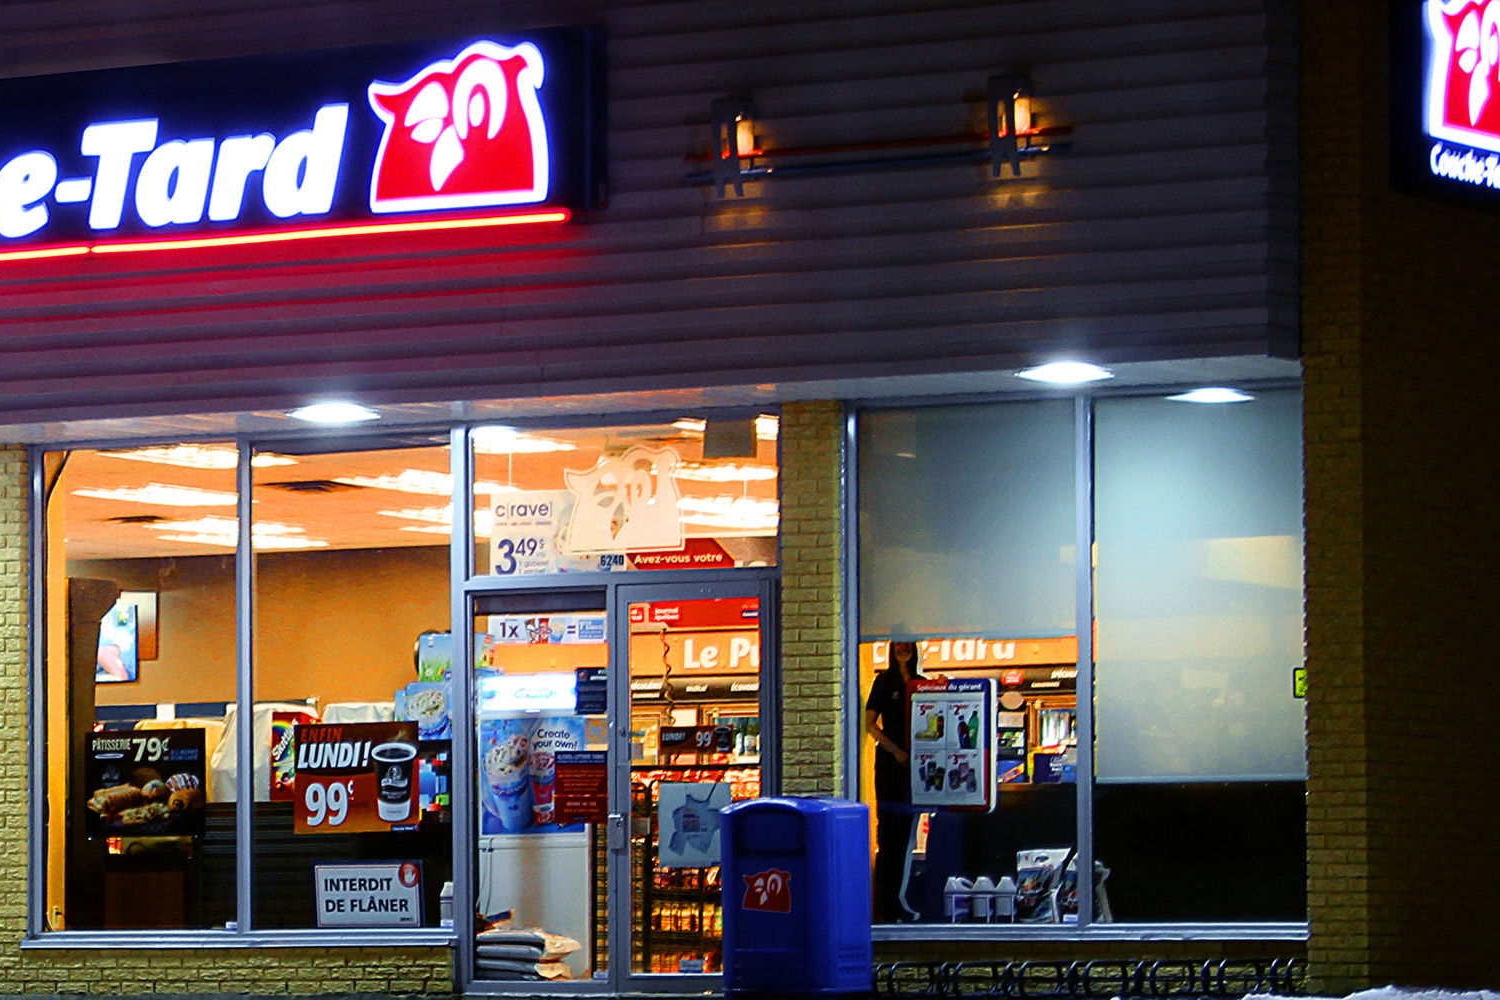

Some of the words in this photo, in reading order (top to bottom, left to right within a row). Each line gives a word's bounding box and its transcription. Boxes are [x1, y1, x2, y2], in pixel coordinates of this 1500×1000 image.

[600, 554, 625, 567] 6240
[634, 554, 691, 565] Avez-vous
[693, 552, 723, 563] votre
[683, 638, 719, 669] Le
[300, 726, 343, 742] ENFIN
[536, 728, 571, 740] Create
[531, 741, 552, 751] your
[554, 740, 578, 750] own!
[324, 878, 393, 892] INTERDIT
[325, 899, 345, 912] DE
[350, 896, 409, 912] FLÂNER
